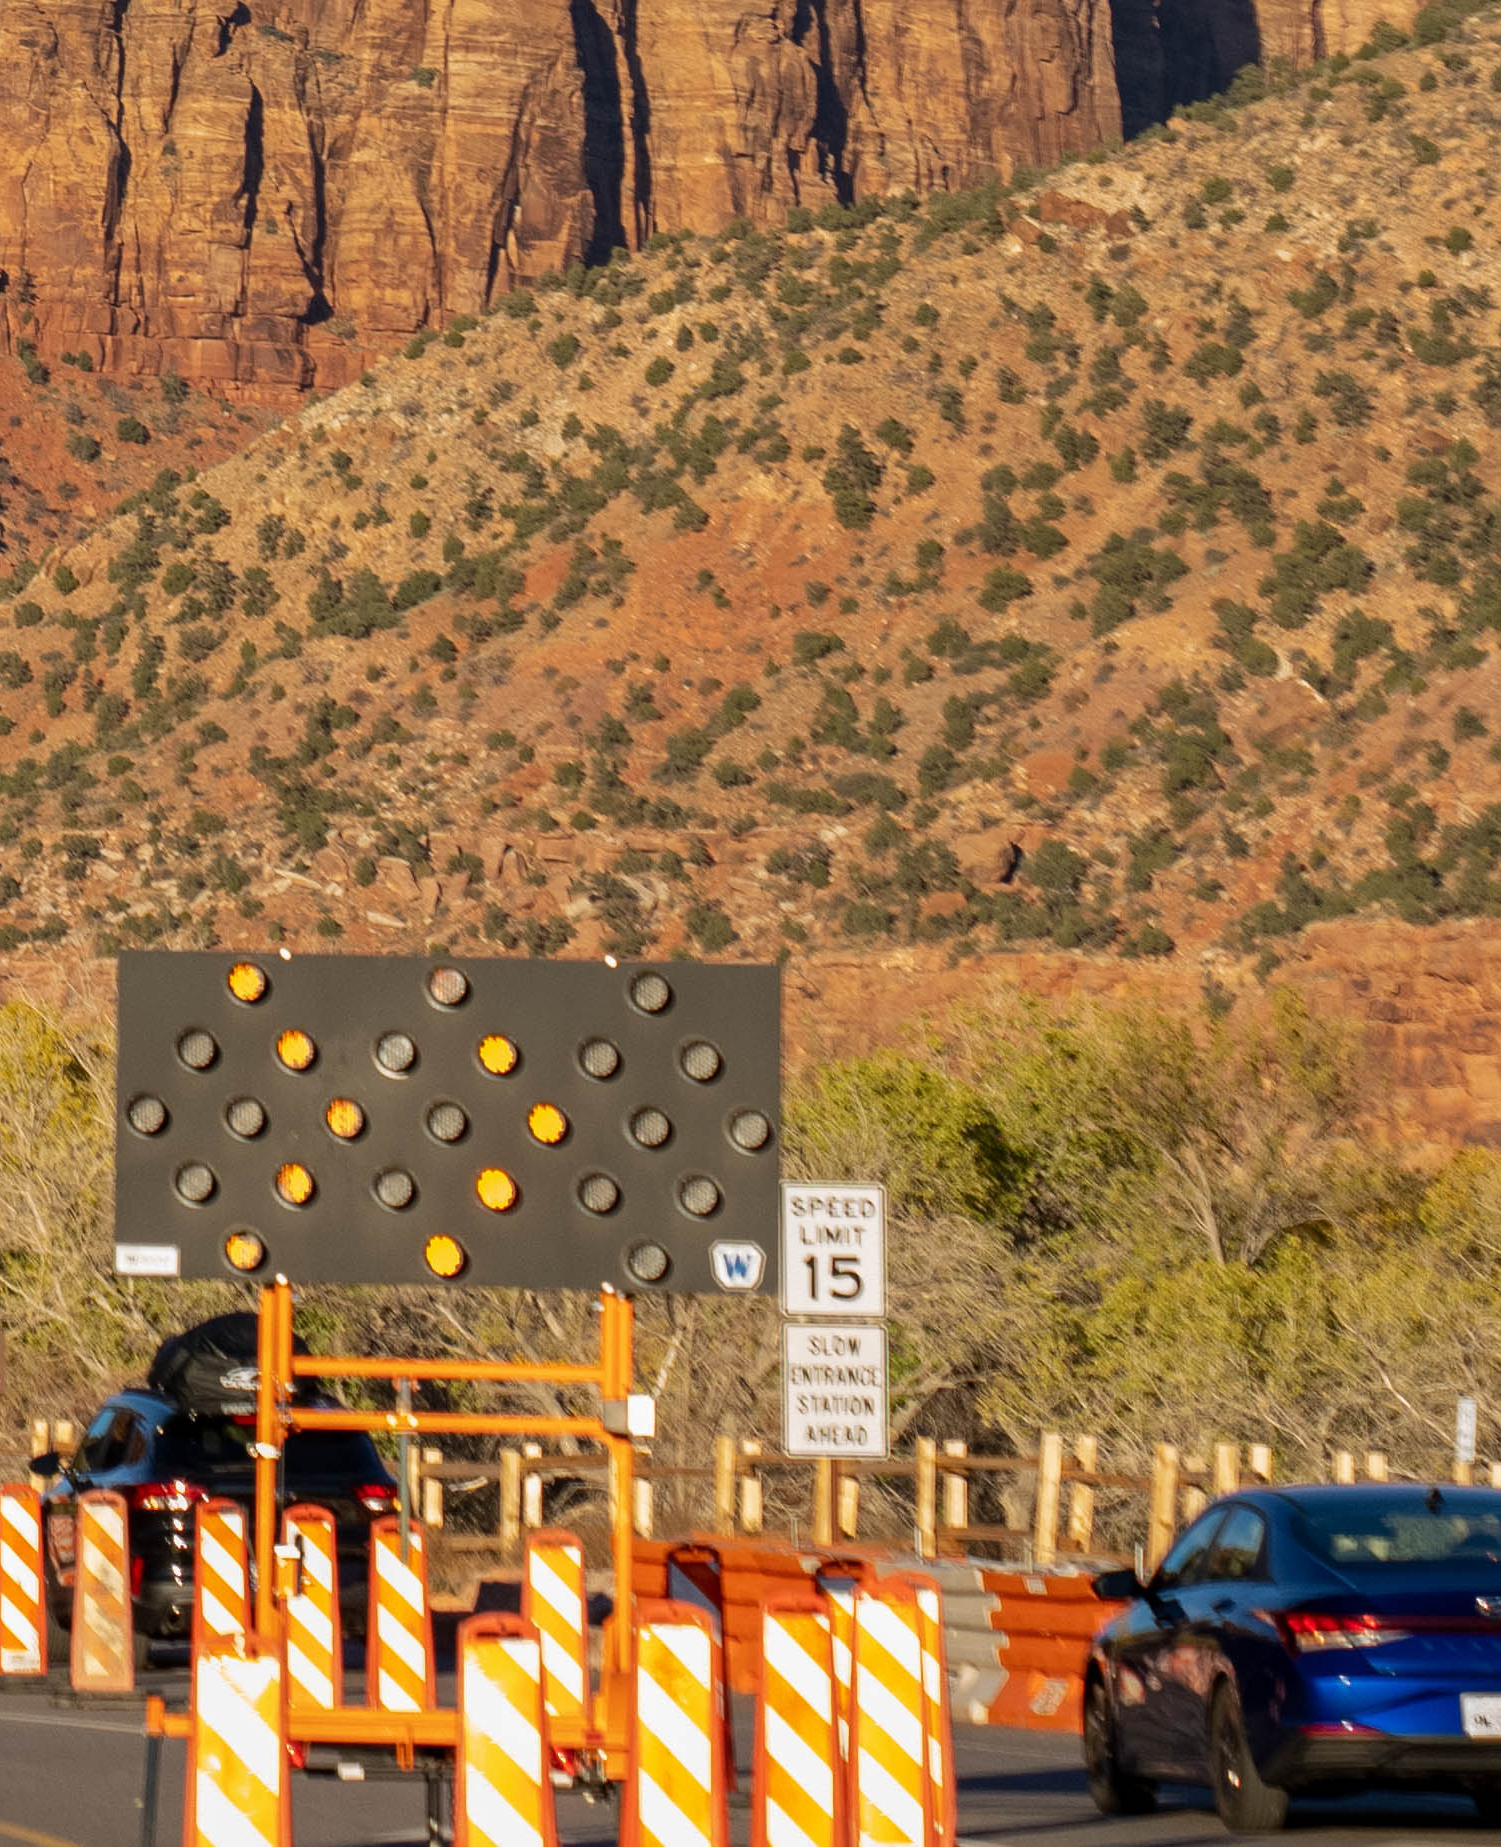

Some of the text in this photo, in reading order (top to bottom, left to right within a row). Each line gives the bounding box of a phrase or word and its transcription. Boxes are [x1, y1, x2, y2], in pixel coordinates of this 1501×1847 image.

[790, 1196, 876, 1218] SPEED
[800, 1224, 866, 1247] LIMIT
[804, 1254, 864, 1302] 15
[807, 1335, 862, 1357] SLOW
[791, 1365, 882, 1387] ENTRANCE
[797, 1394, 875, 1416] STATION
[807, 1424, 868, 1446] AHEAD
